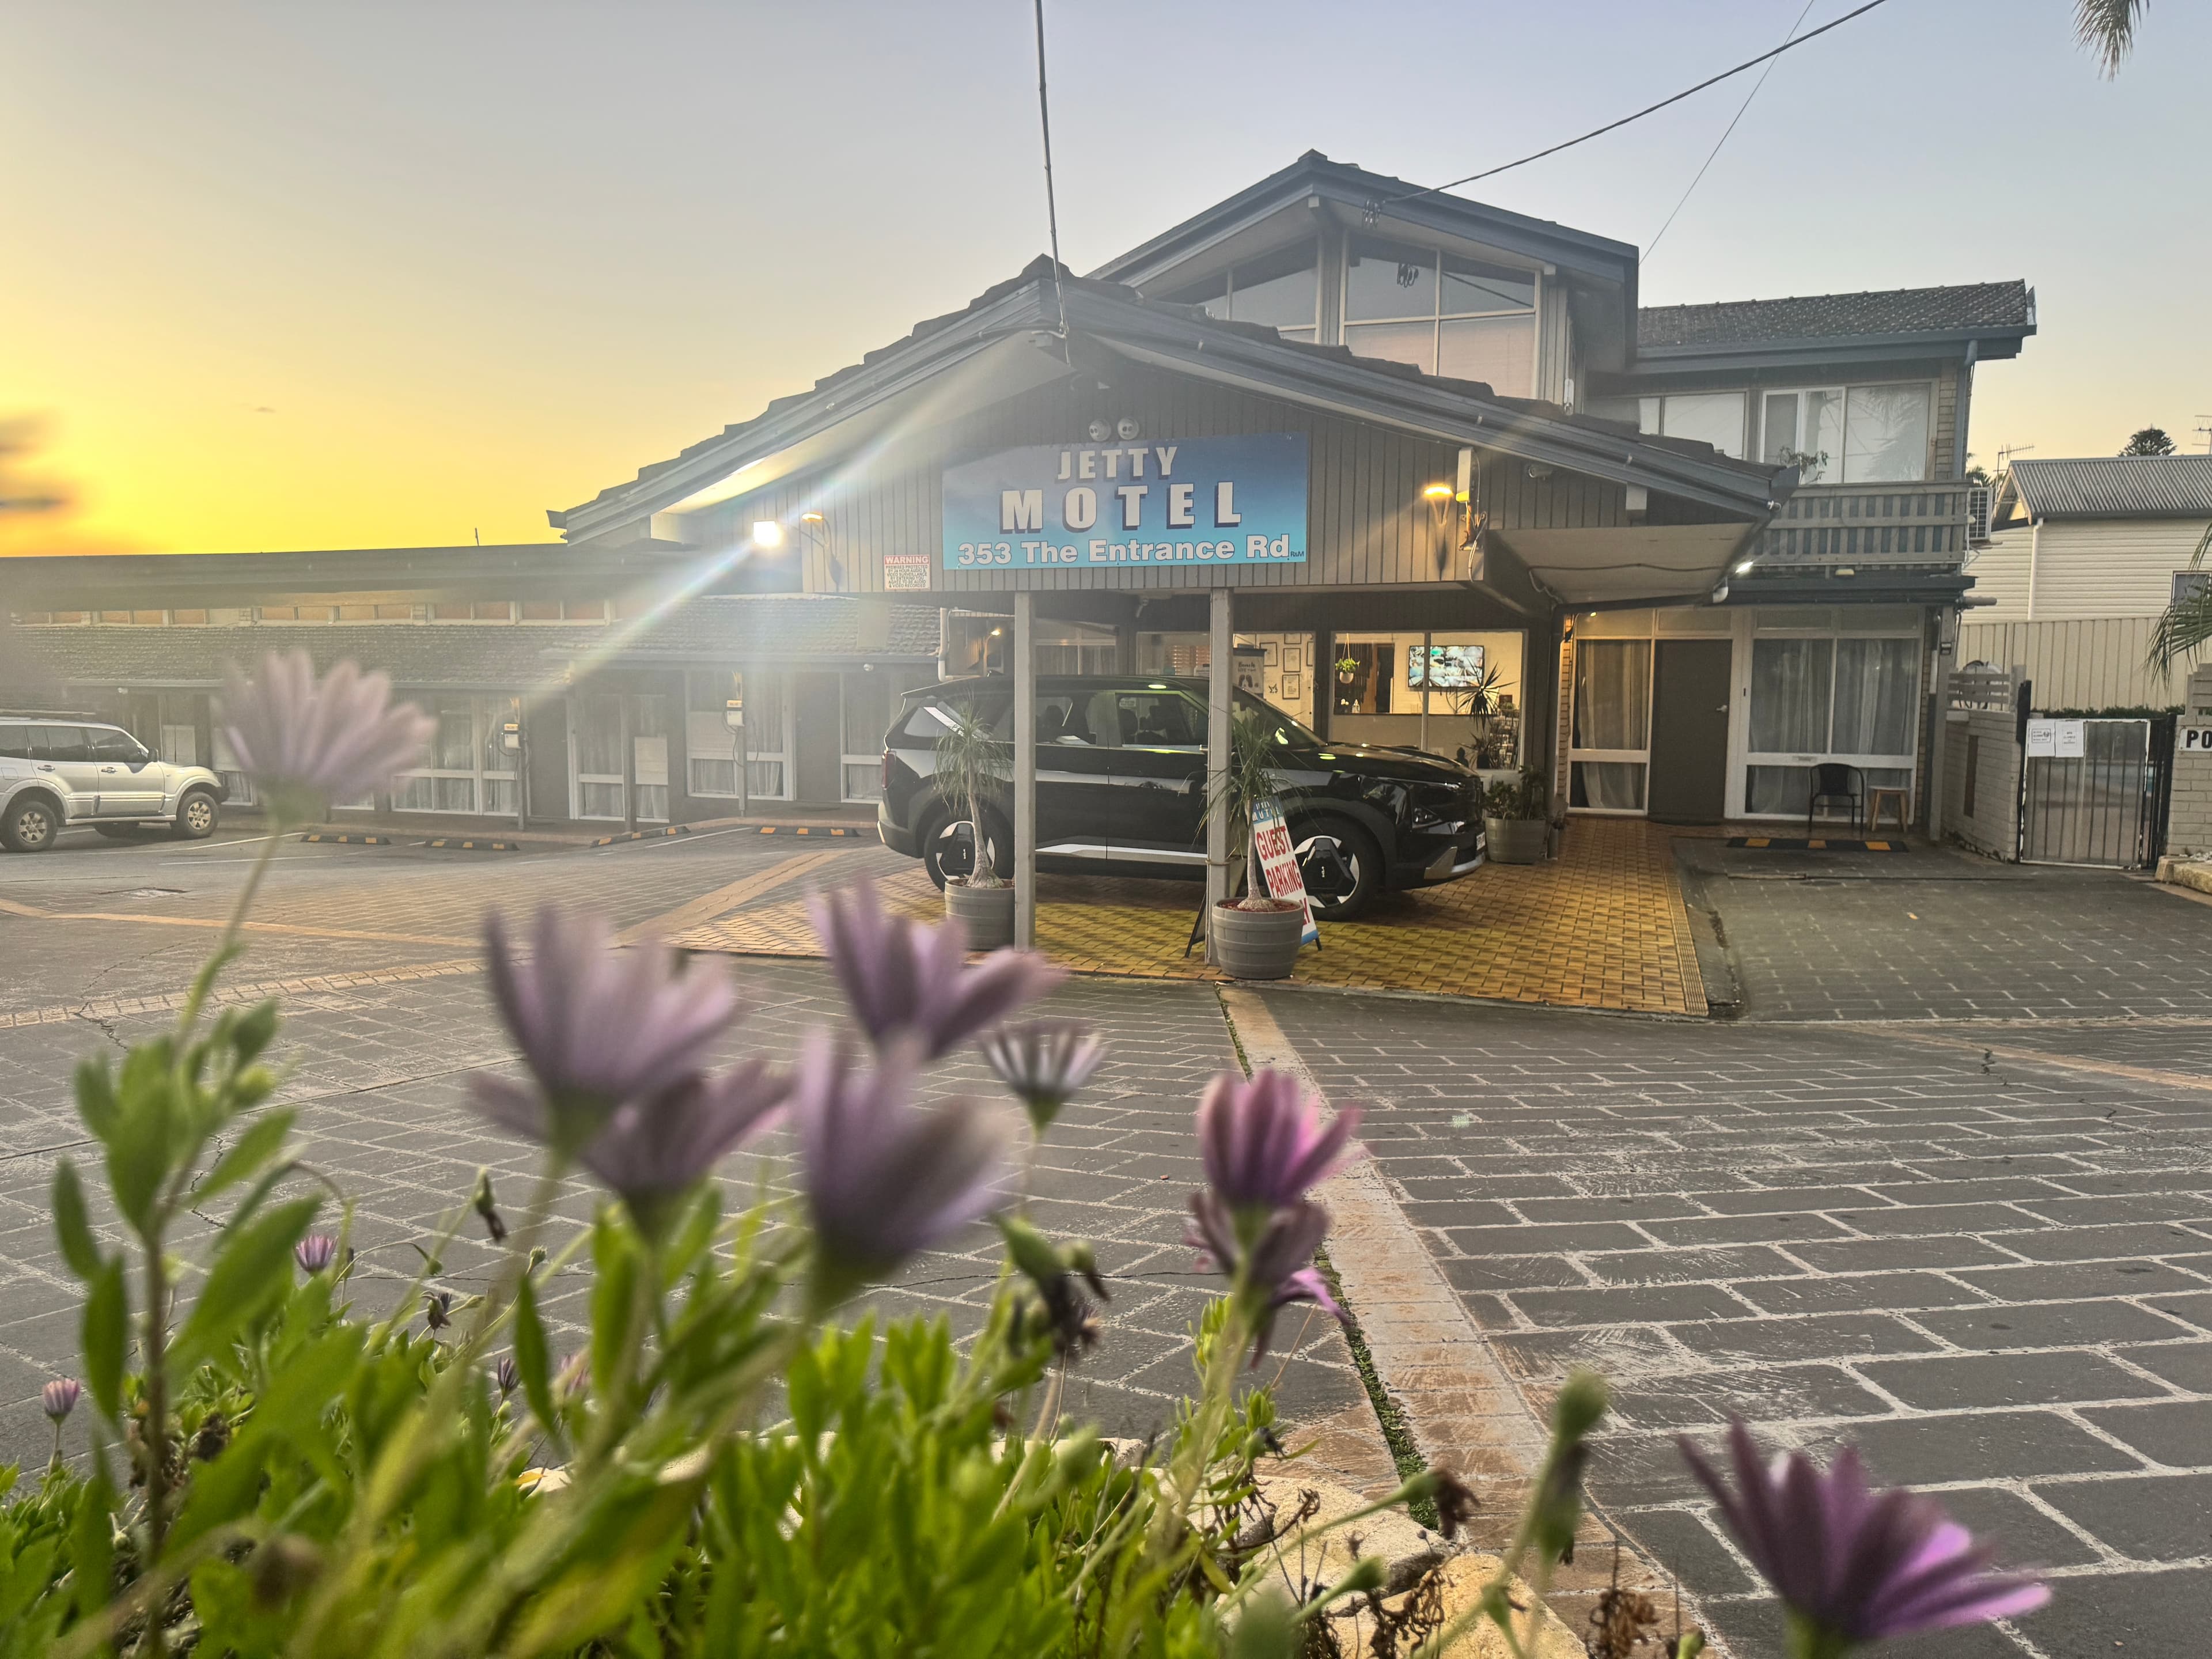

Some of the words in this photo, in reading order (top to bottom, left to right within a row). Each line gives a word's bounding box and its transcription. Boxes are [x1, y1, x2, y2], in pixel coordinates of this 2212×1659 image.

[1056, 446, 1177, 482] JETTY
[1001, 482, 1241, 532] MOTEL
[885, 556, 929, 564] WARNING
[958, 542, 1012, 565] 353
[1021, 541, 1078, 563] The
[1088, 539, 1235, 562] Entrance
[1246, 533, 1290, 558] Rd
[1256, 825, 1291, 861] GUEST
[1266, 859, 1303, 899] PARKING
